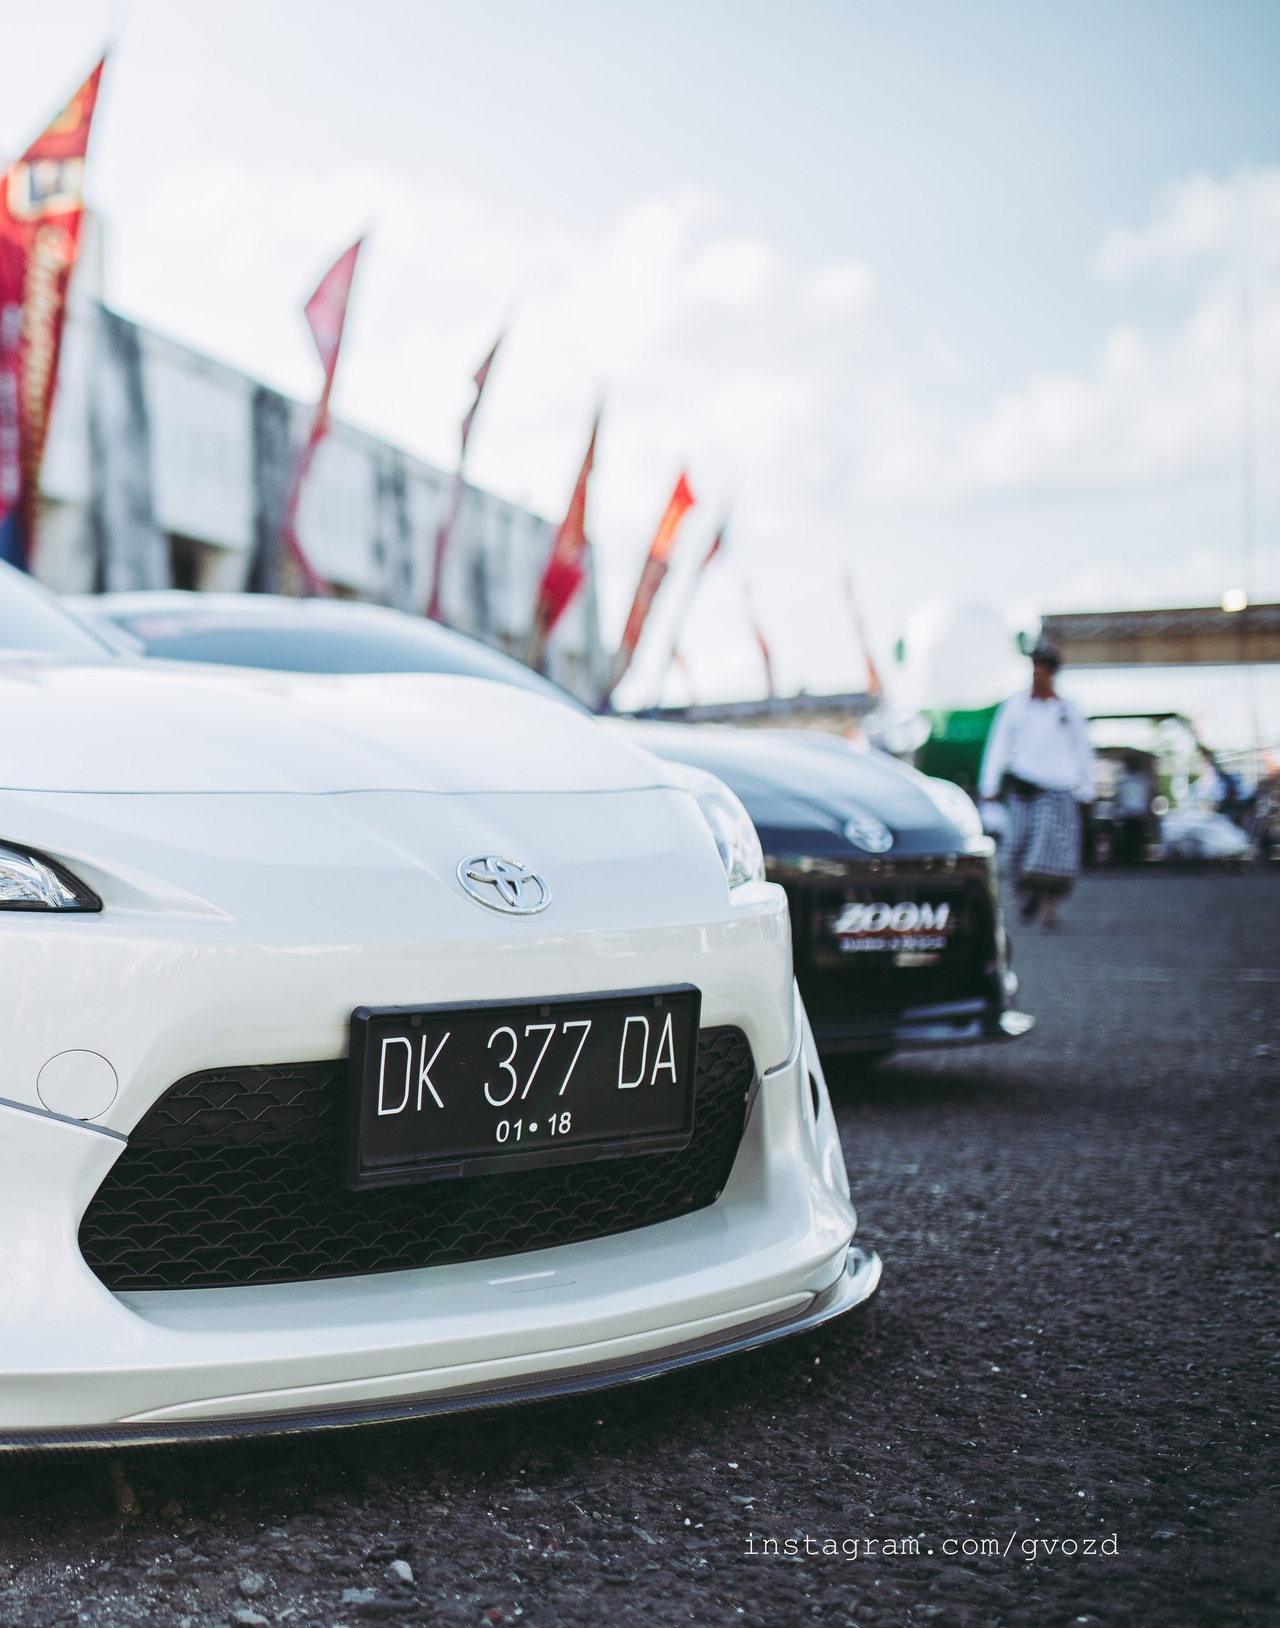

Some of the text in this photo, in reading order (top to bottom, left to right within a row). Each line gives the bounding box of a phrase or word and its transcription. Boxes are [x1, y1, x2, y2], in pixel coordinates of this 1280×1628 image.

[833, 901, 951, 934] ZOOM
[378, 1013, 676, 1115] DK 377 DA
